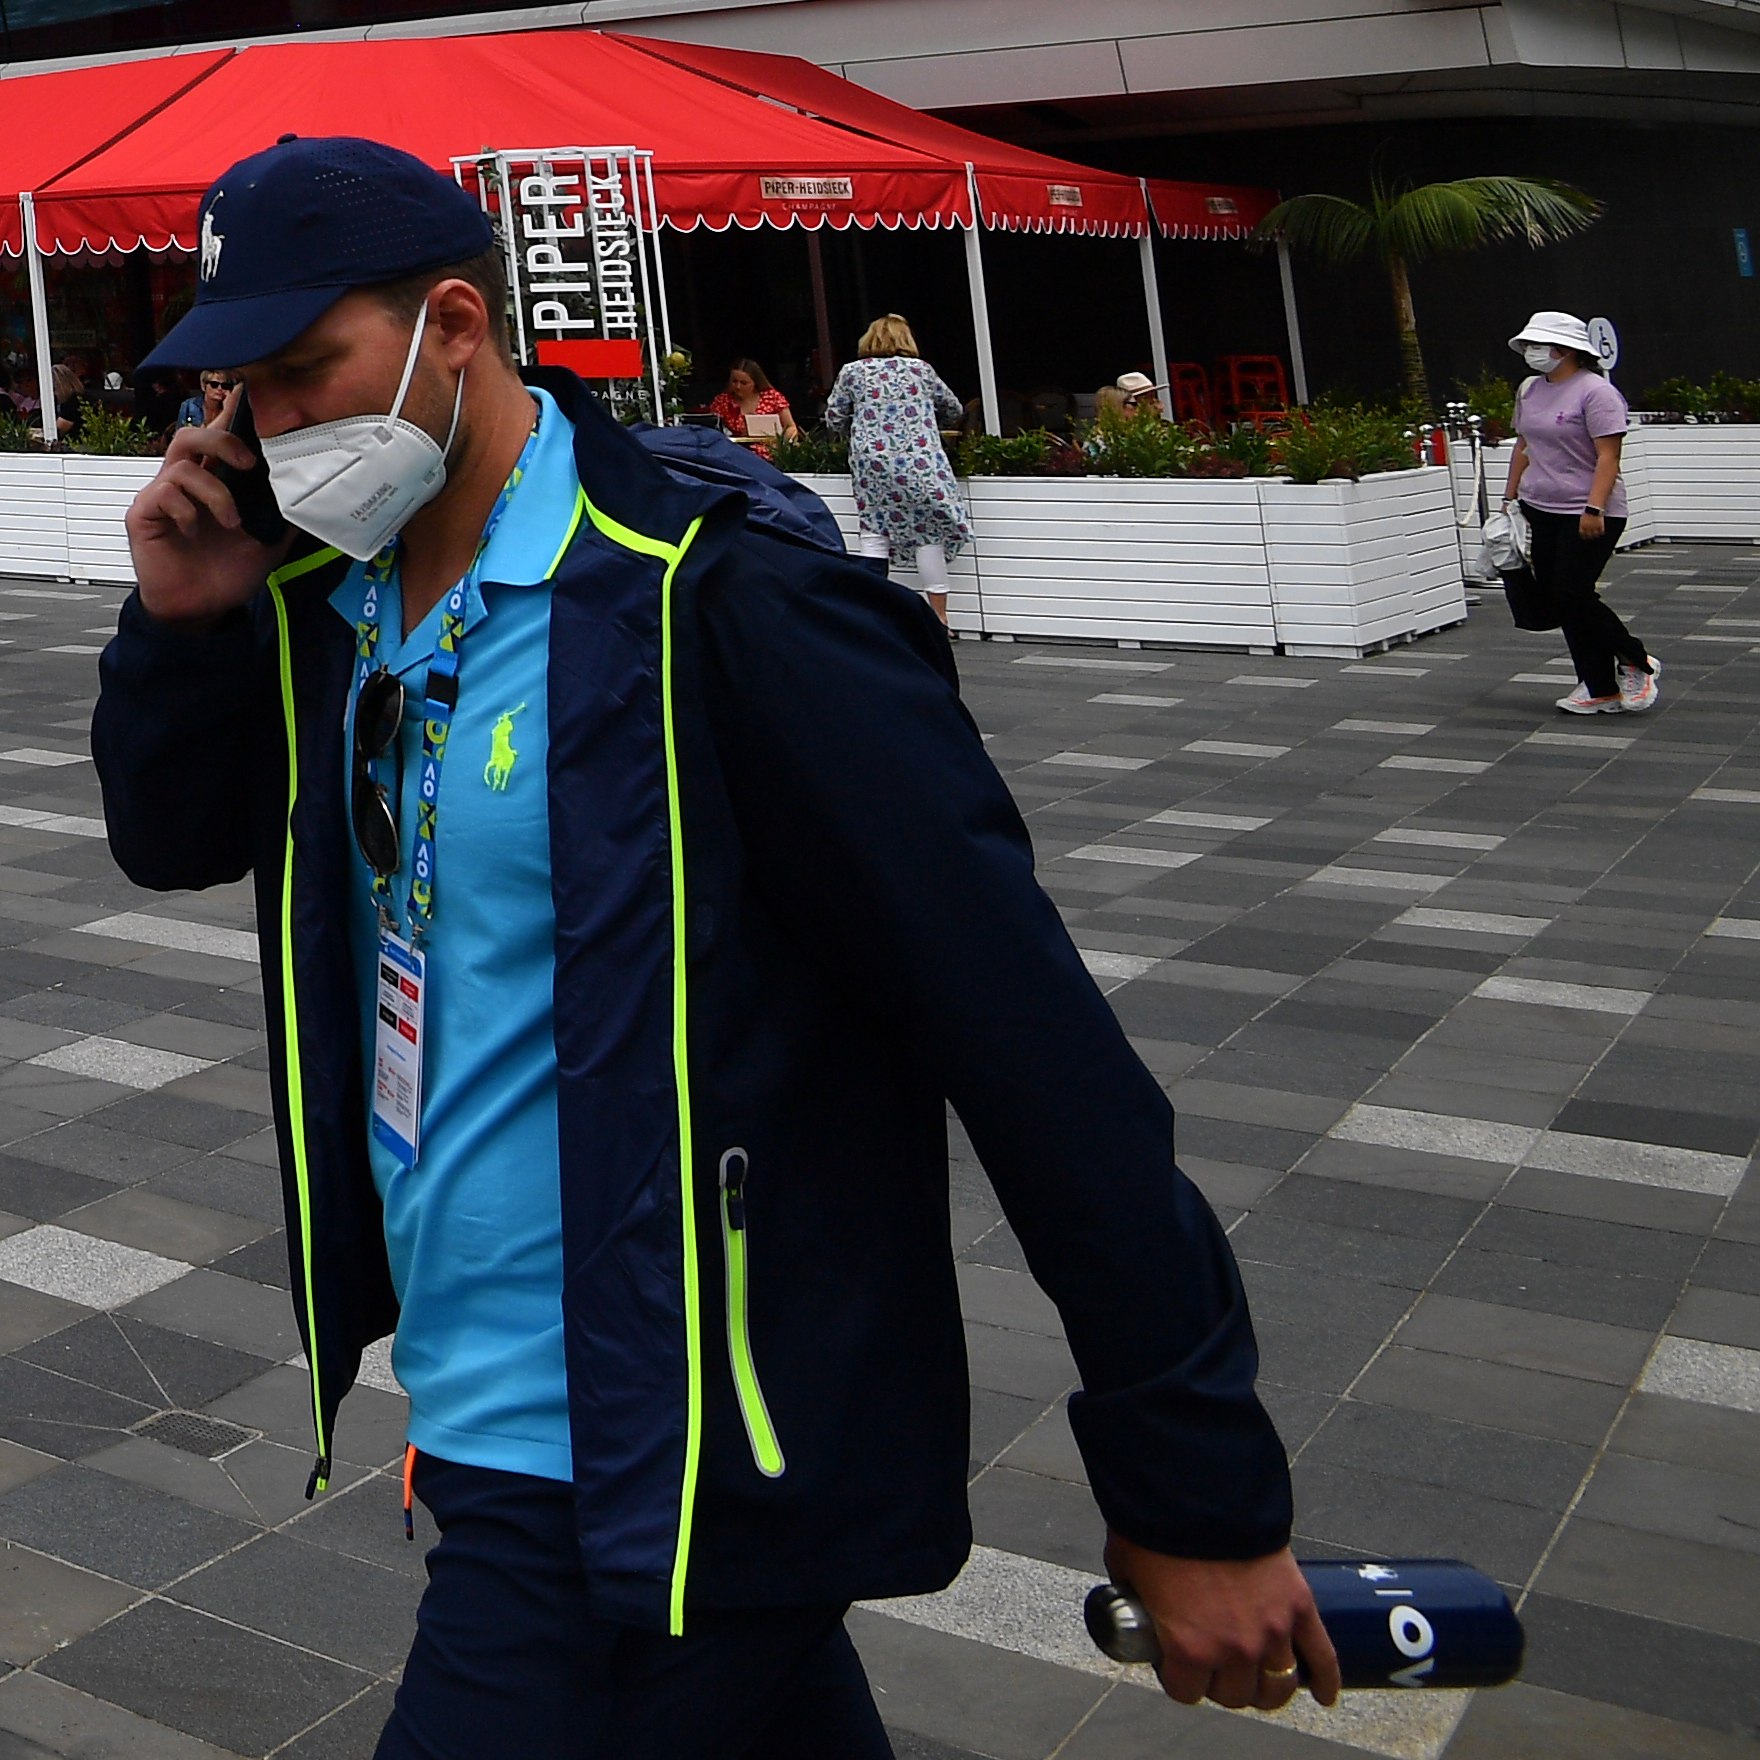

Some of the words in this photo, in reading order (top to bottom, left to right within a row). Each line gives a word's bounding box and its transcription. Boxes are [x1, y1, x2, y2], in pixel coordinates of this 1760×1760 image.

[518, 173, 596, 330] PIPER
[589, 172, 639, 330] HEIDSIECK
[764, 181, 851, 195] PIPER-HEIDSIECK
